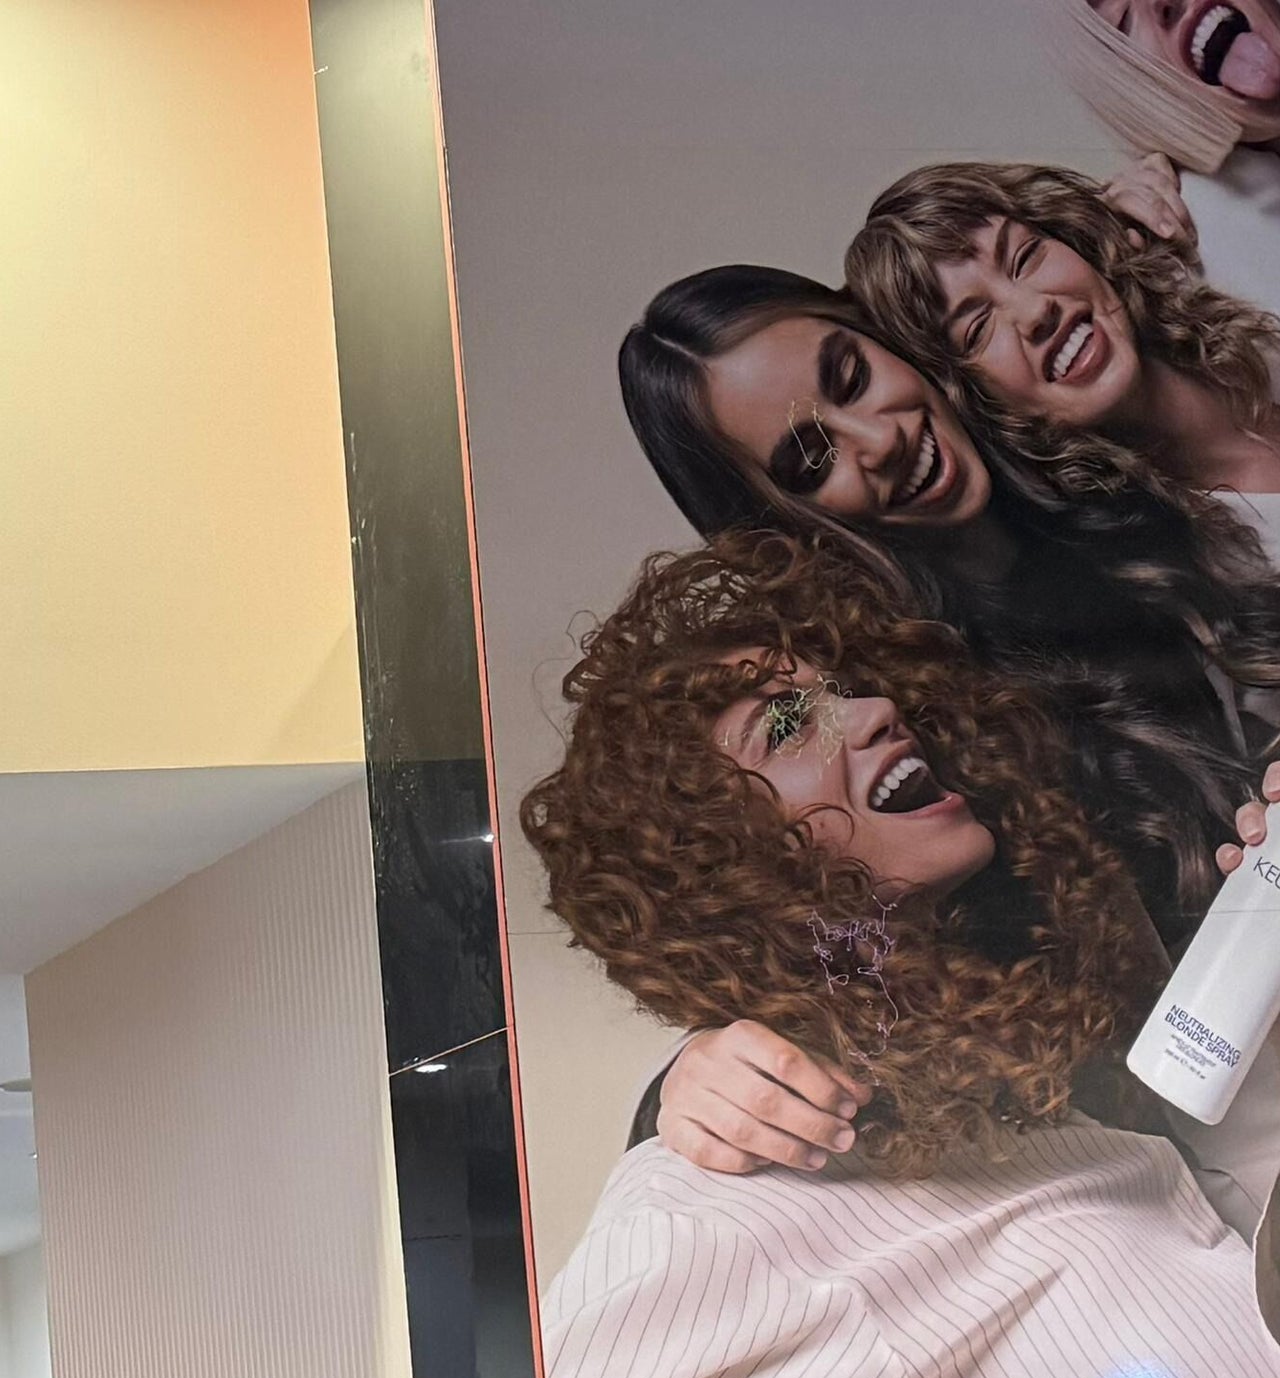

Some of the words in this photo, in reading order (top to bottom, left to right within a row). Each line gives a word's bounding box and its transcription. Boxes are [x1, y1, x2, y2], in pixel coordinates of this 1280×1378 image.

[1164, 1012, 1208, 1046] BLONDE
[1205, 1042, 1238, 1068] SPRAY
[1170, 1004, 1242, 1060] NEUTRALIZING
